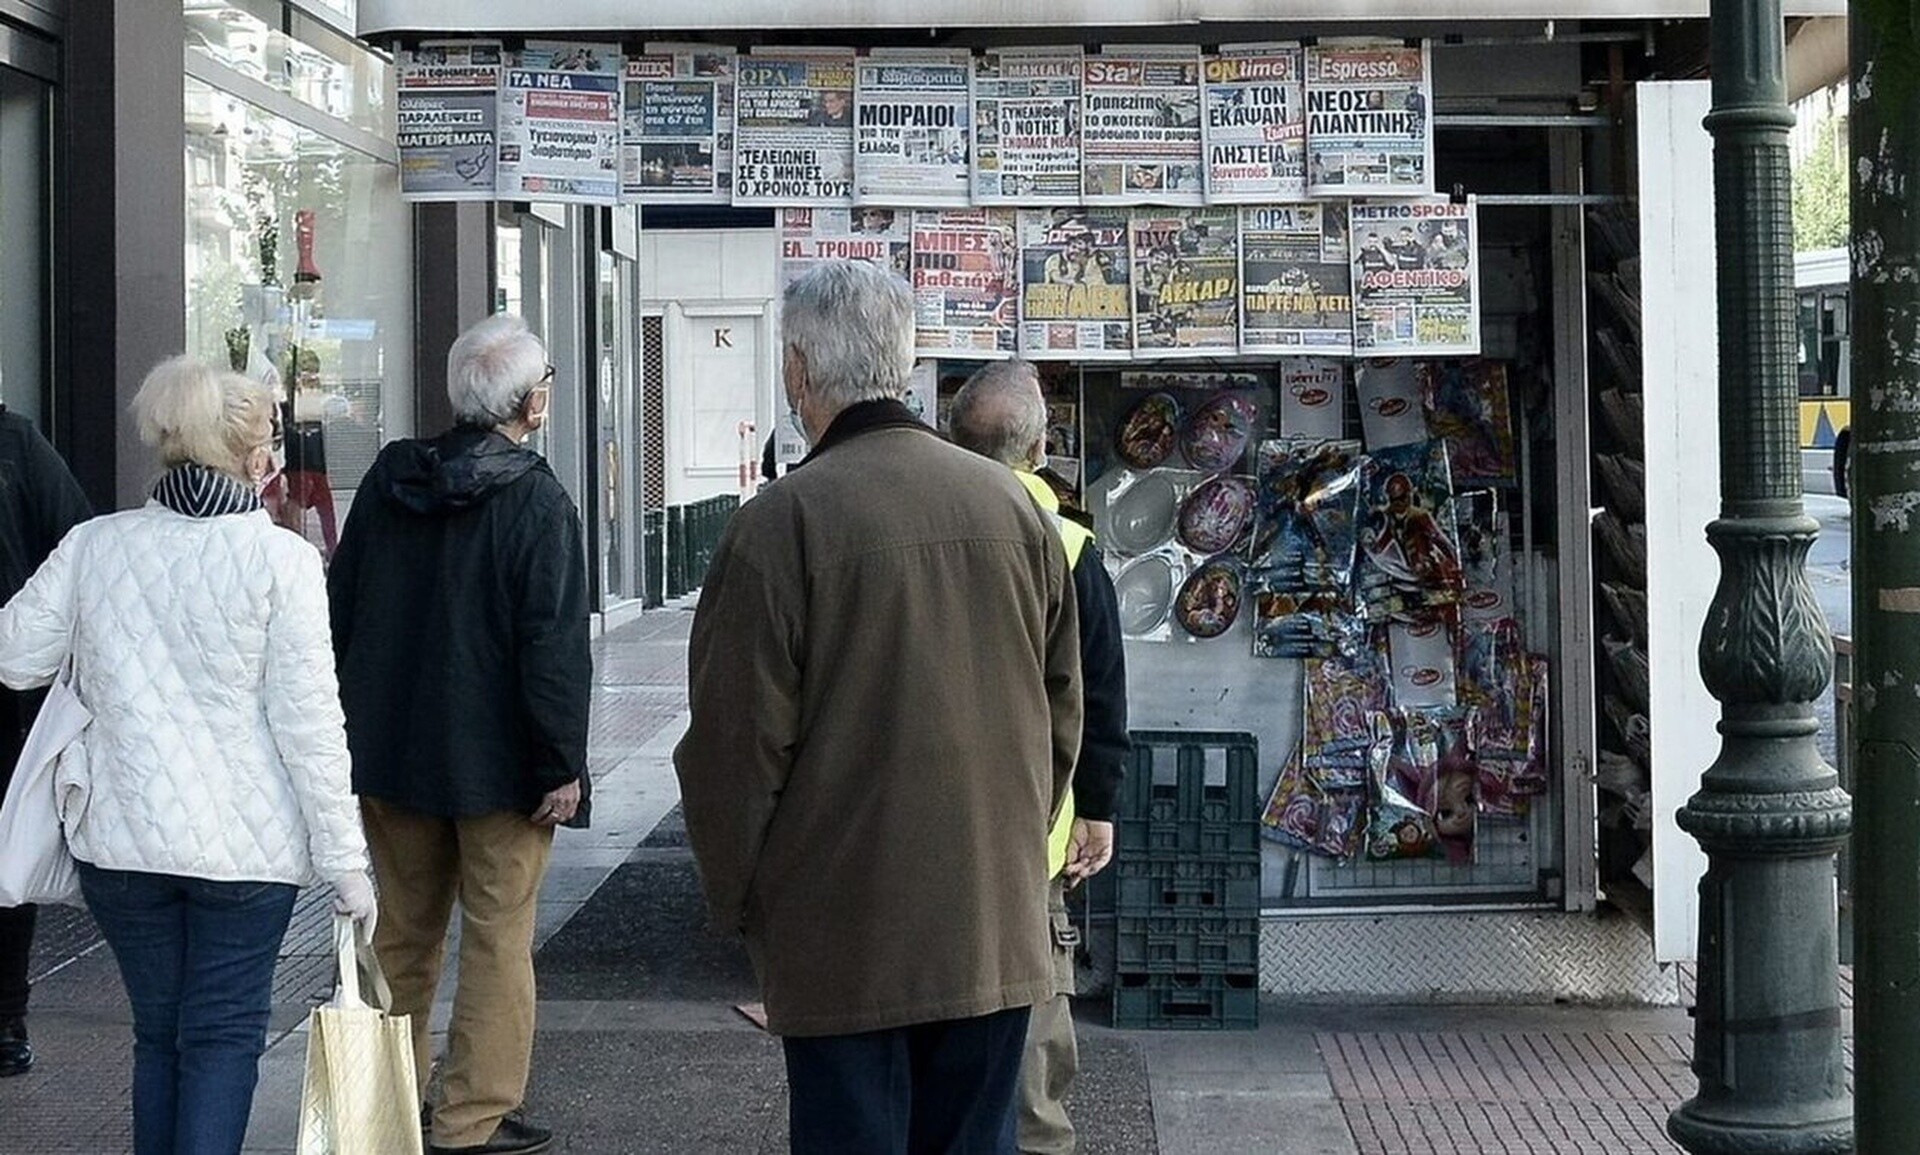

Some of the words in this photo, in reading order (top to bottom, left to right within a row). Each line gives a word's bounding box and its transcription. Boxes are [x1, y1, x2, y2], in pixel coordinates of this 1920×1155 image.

[740, 68, 788, 86] ΩΡΑ
[1321, 57, 1398, 80] Espresso
[512, 73, 532, 87] ΤΑ
[537, 74, 572, 89] ΝΕΑ
[1251, 86, 1286, 104] ΤΟΝ
[1308, 91, 1366, 112] ΝΕΟΣ
[667, 115, 682, 124] 67
[859, 104, 954, 127] ΜΟΙΡΑΙΟΙ
[1085, 116, 1099, 128] το
[1210, 107, 1286, 127] ΕΚΑΨΑΝ
[1309, 113, 1416, 135] ΛΙΑΝΤΙΝΗΣ
[1002, 121, 1011, 135] Ο
[1016, 120, 1059, 135] ΝΟΤΗΣ
[1141, 131, 1162, 140] του
[739, 166, 756, 180] ΣΕ
[760, 166, 769, 180] 6
[774, 166, 821, 181] ΜΗΝΕΣ
[739, 182, 748, 197] Ο
[754, 182, 810, 197] ΧΡΟΝΟΣ
[1257, 209, 1293, 230] ΩΡΑ
[1352, 204, 1467, 218] METROSPORT
[815, 241, 885, 259] ΤΡΟΜΟΣ
[914, 232, 988, 252] ΜΠΕΣ
[1361, 270, 1464, 287] ΑΦΕΝΤΙΚΟ
